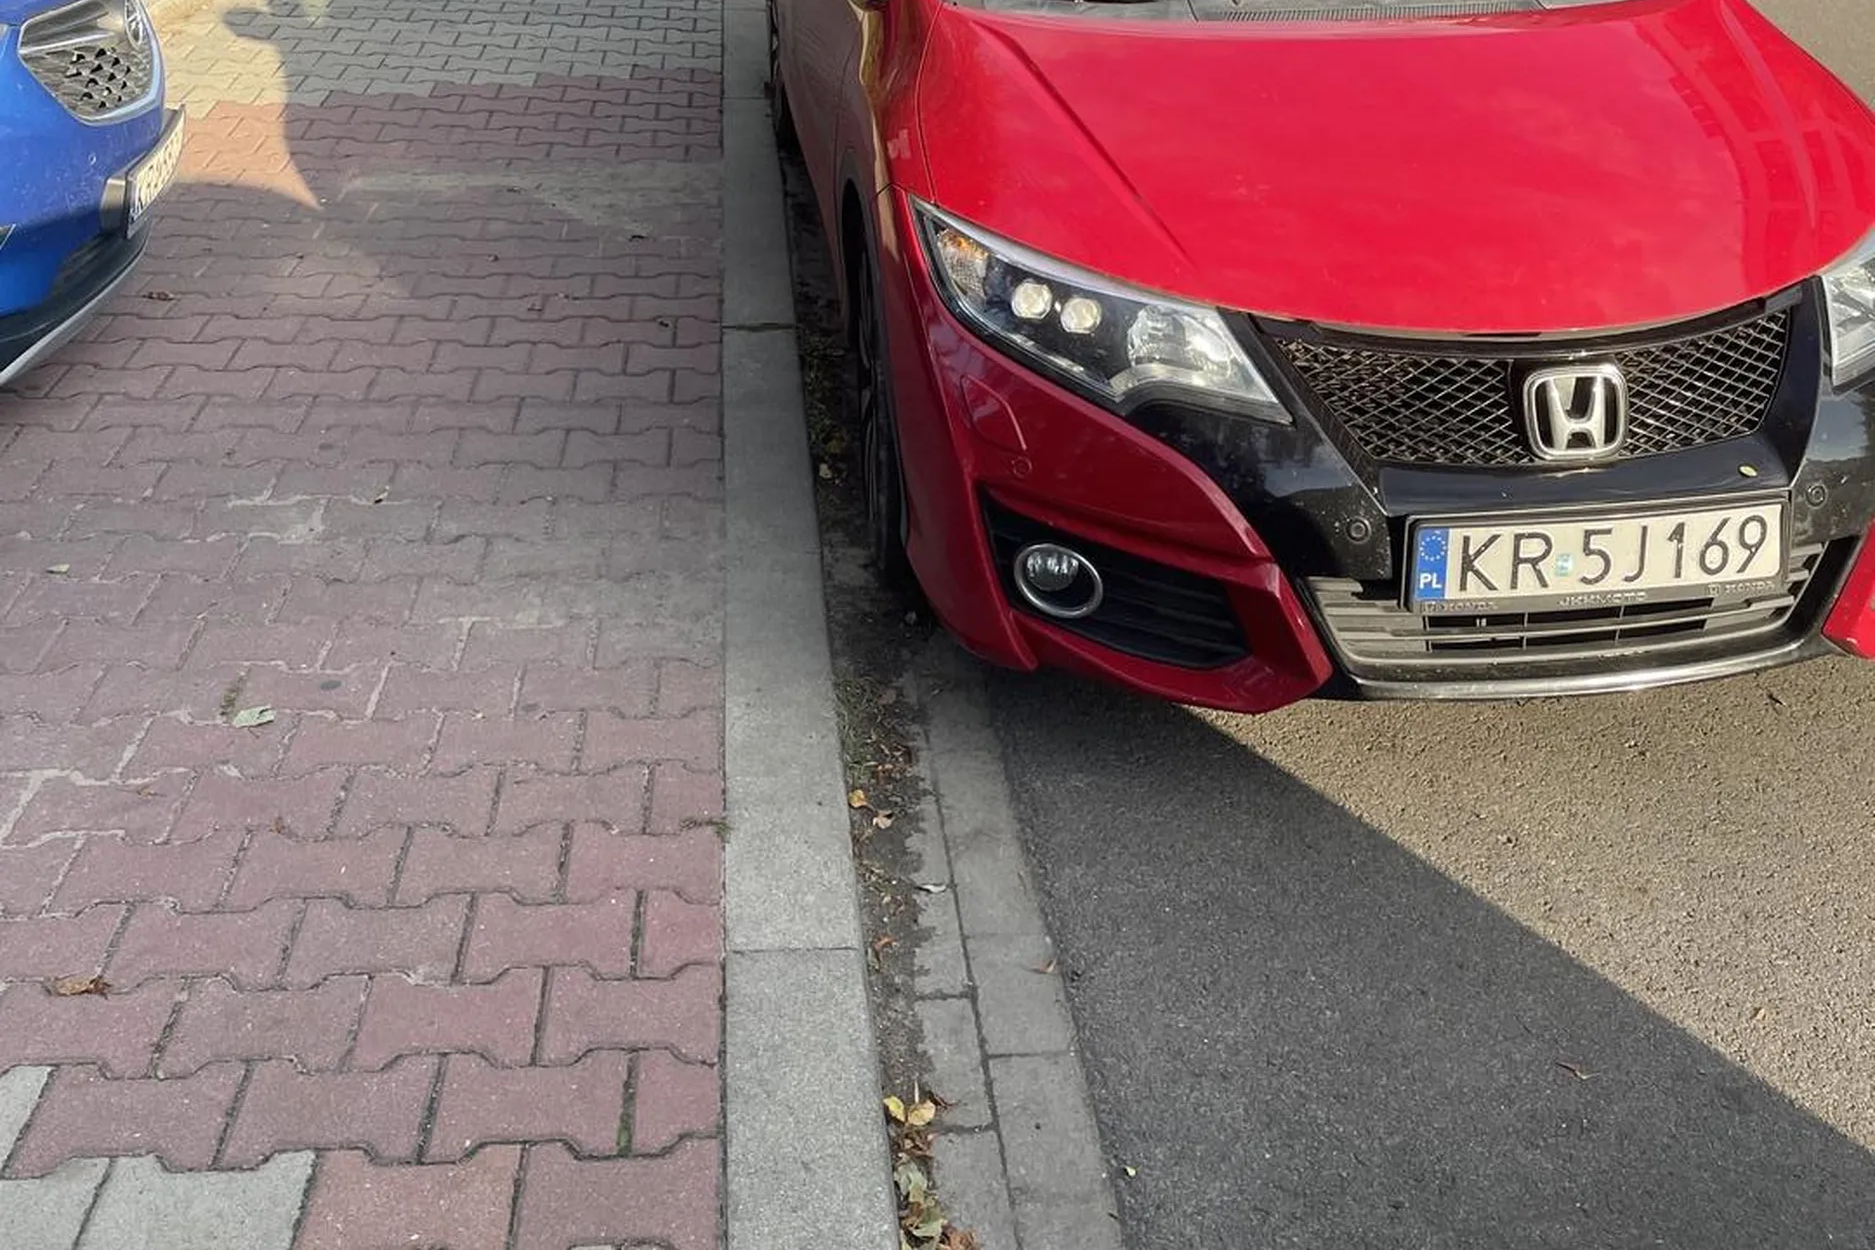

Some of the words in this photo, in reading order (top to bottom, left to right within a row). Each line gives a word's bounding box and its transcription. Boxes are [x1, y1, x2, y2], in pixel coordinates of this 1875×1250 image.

[1541, 372, 1610, 454] H
[1418, 572, 1443, 589] PL
[1459, 532, 1553, 592] KR
[1579, 515, 1768, 586] 5J169
